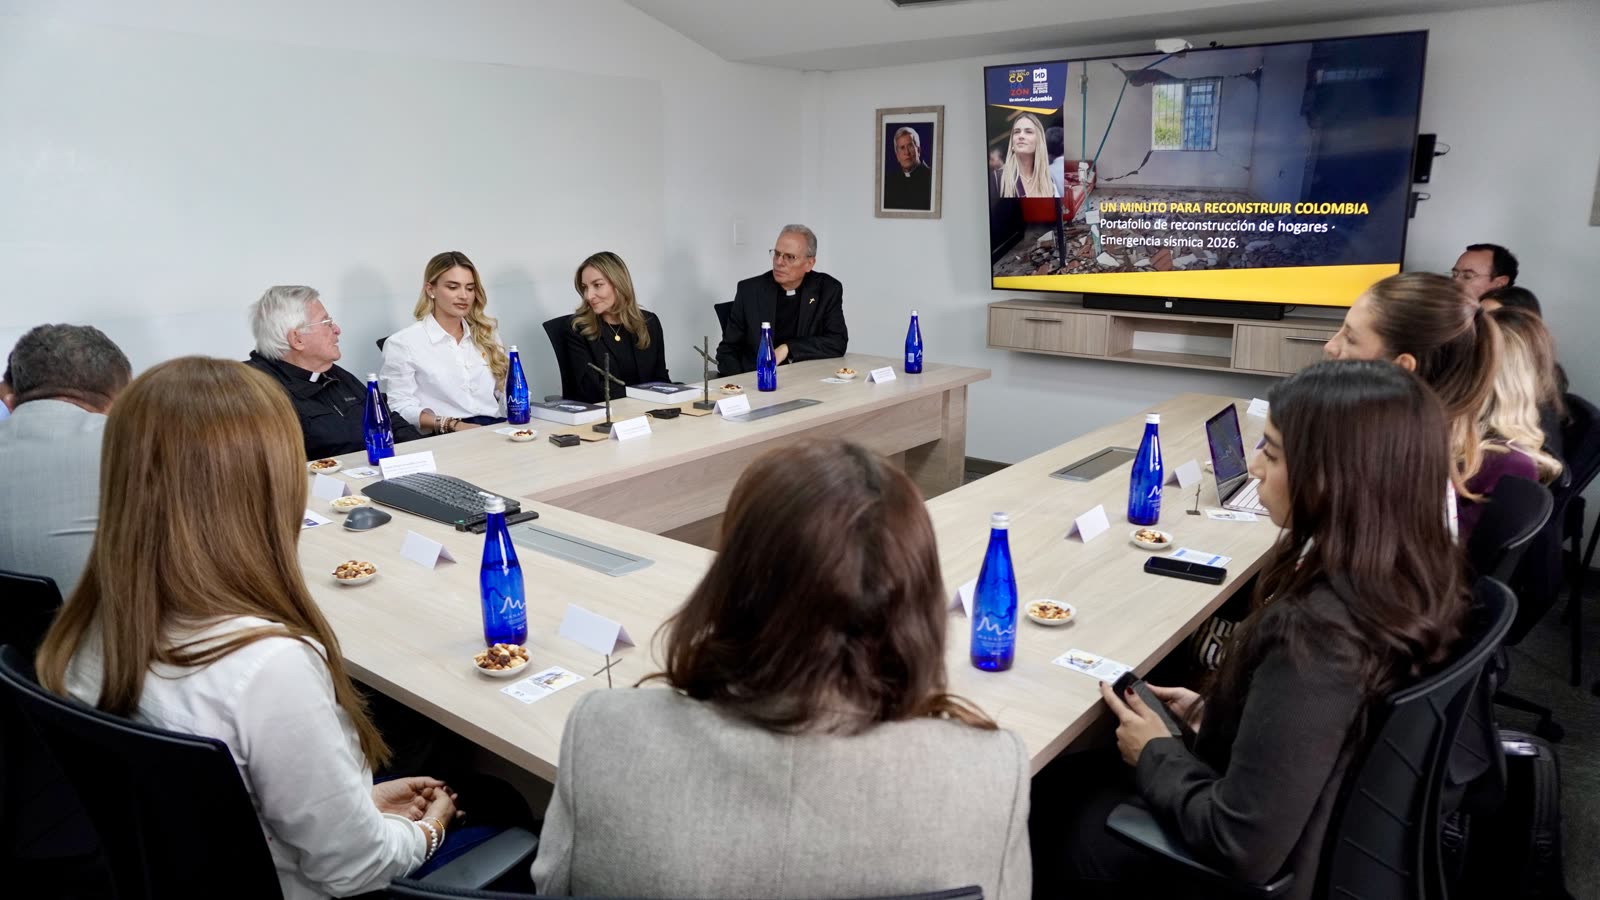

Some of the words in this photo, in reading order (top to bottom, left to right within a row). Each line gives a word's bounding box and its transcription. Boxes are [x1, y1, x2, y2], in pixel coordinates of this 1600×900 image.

[1100, 202, 1117, 212] UN
[1120, 202, 1167, 213] MINUTO
[1170, 202, 1201, 213] PARA
[1204, 202, 1291, 214] RECONSTRUIR
[1295, 202, 1369, 215] COLOMBIA
[1100, 218, 1151, 230] Portafolio
[1153, 219, 1168, 230] de
[1170, 219, 1255, 232] reconstrucción
[1259, 220, 1275, 232] de
[1278, 220, 1328, 235] hogares
[1100, 235, 1160, 247] Emergencia
[1163, 236, 1204, 248] sísmica
[1206, 237, 1239, 249] 2026.
